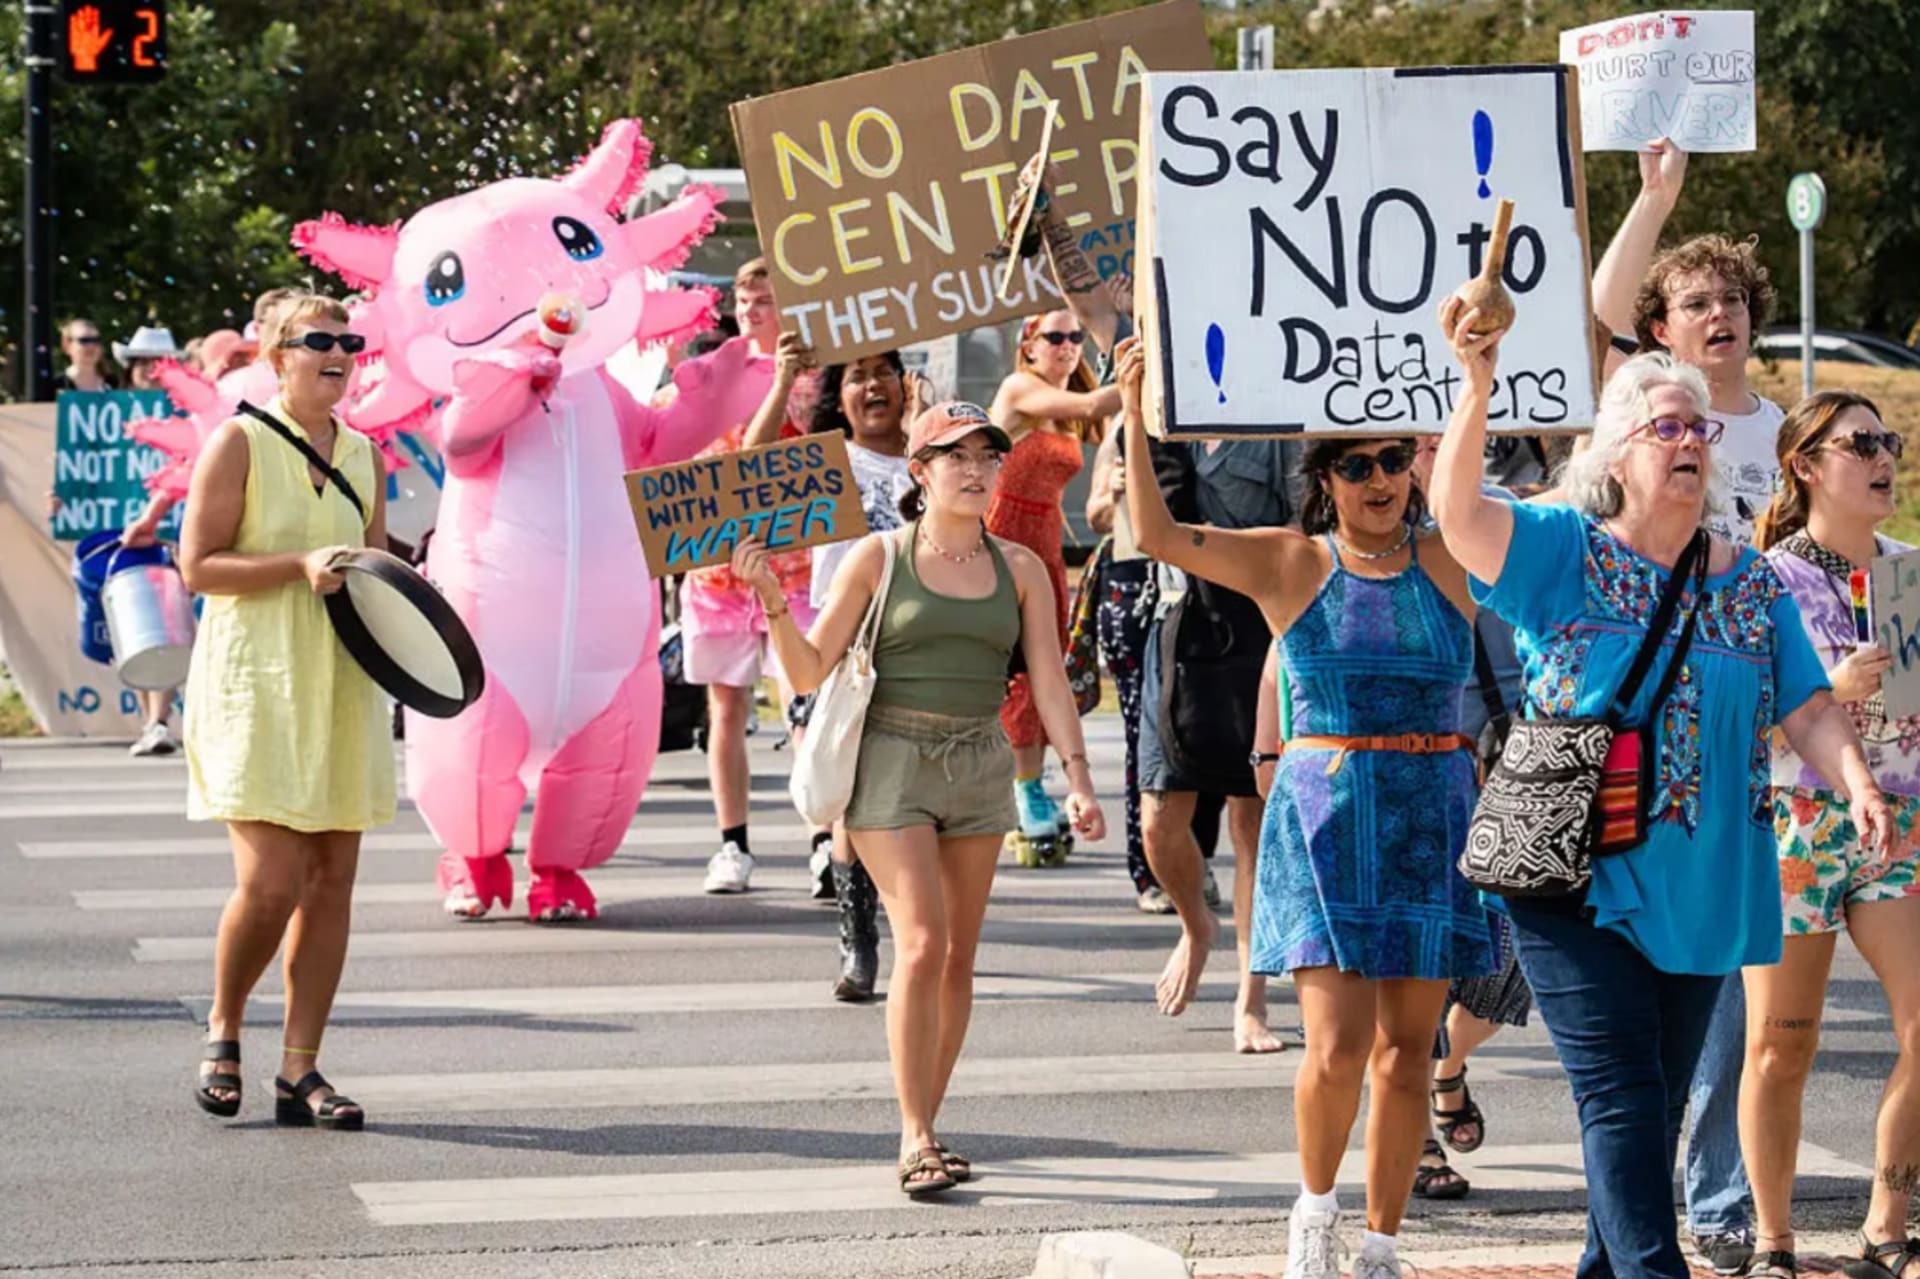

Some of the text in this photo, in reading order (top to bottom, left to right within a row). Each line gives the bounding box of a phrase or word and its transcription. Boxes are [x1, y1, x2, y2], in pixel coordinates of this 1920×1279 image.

[132, 9, 158, 67] 2
[773, 46, 1147, 201] NO DATA
[1159, 84, 1339, 212] Say
[1249, 187, 1547, 317] NO to
[782, 255, 1064, 349] THEY SUCK
[1278, 318, 1431, 384] Data
[69, 401, 122, 444] NO
[57, 448, 121, 483] NOT
[640, 442, 825, 501] DON'T MESS
[56, 497, 118, 532] NOT
[647, 469, 843, 530] WITH TEXAS
[666, 498, 837, 565] WATER
[58, 684, 101, 714] NO
